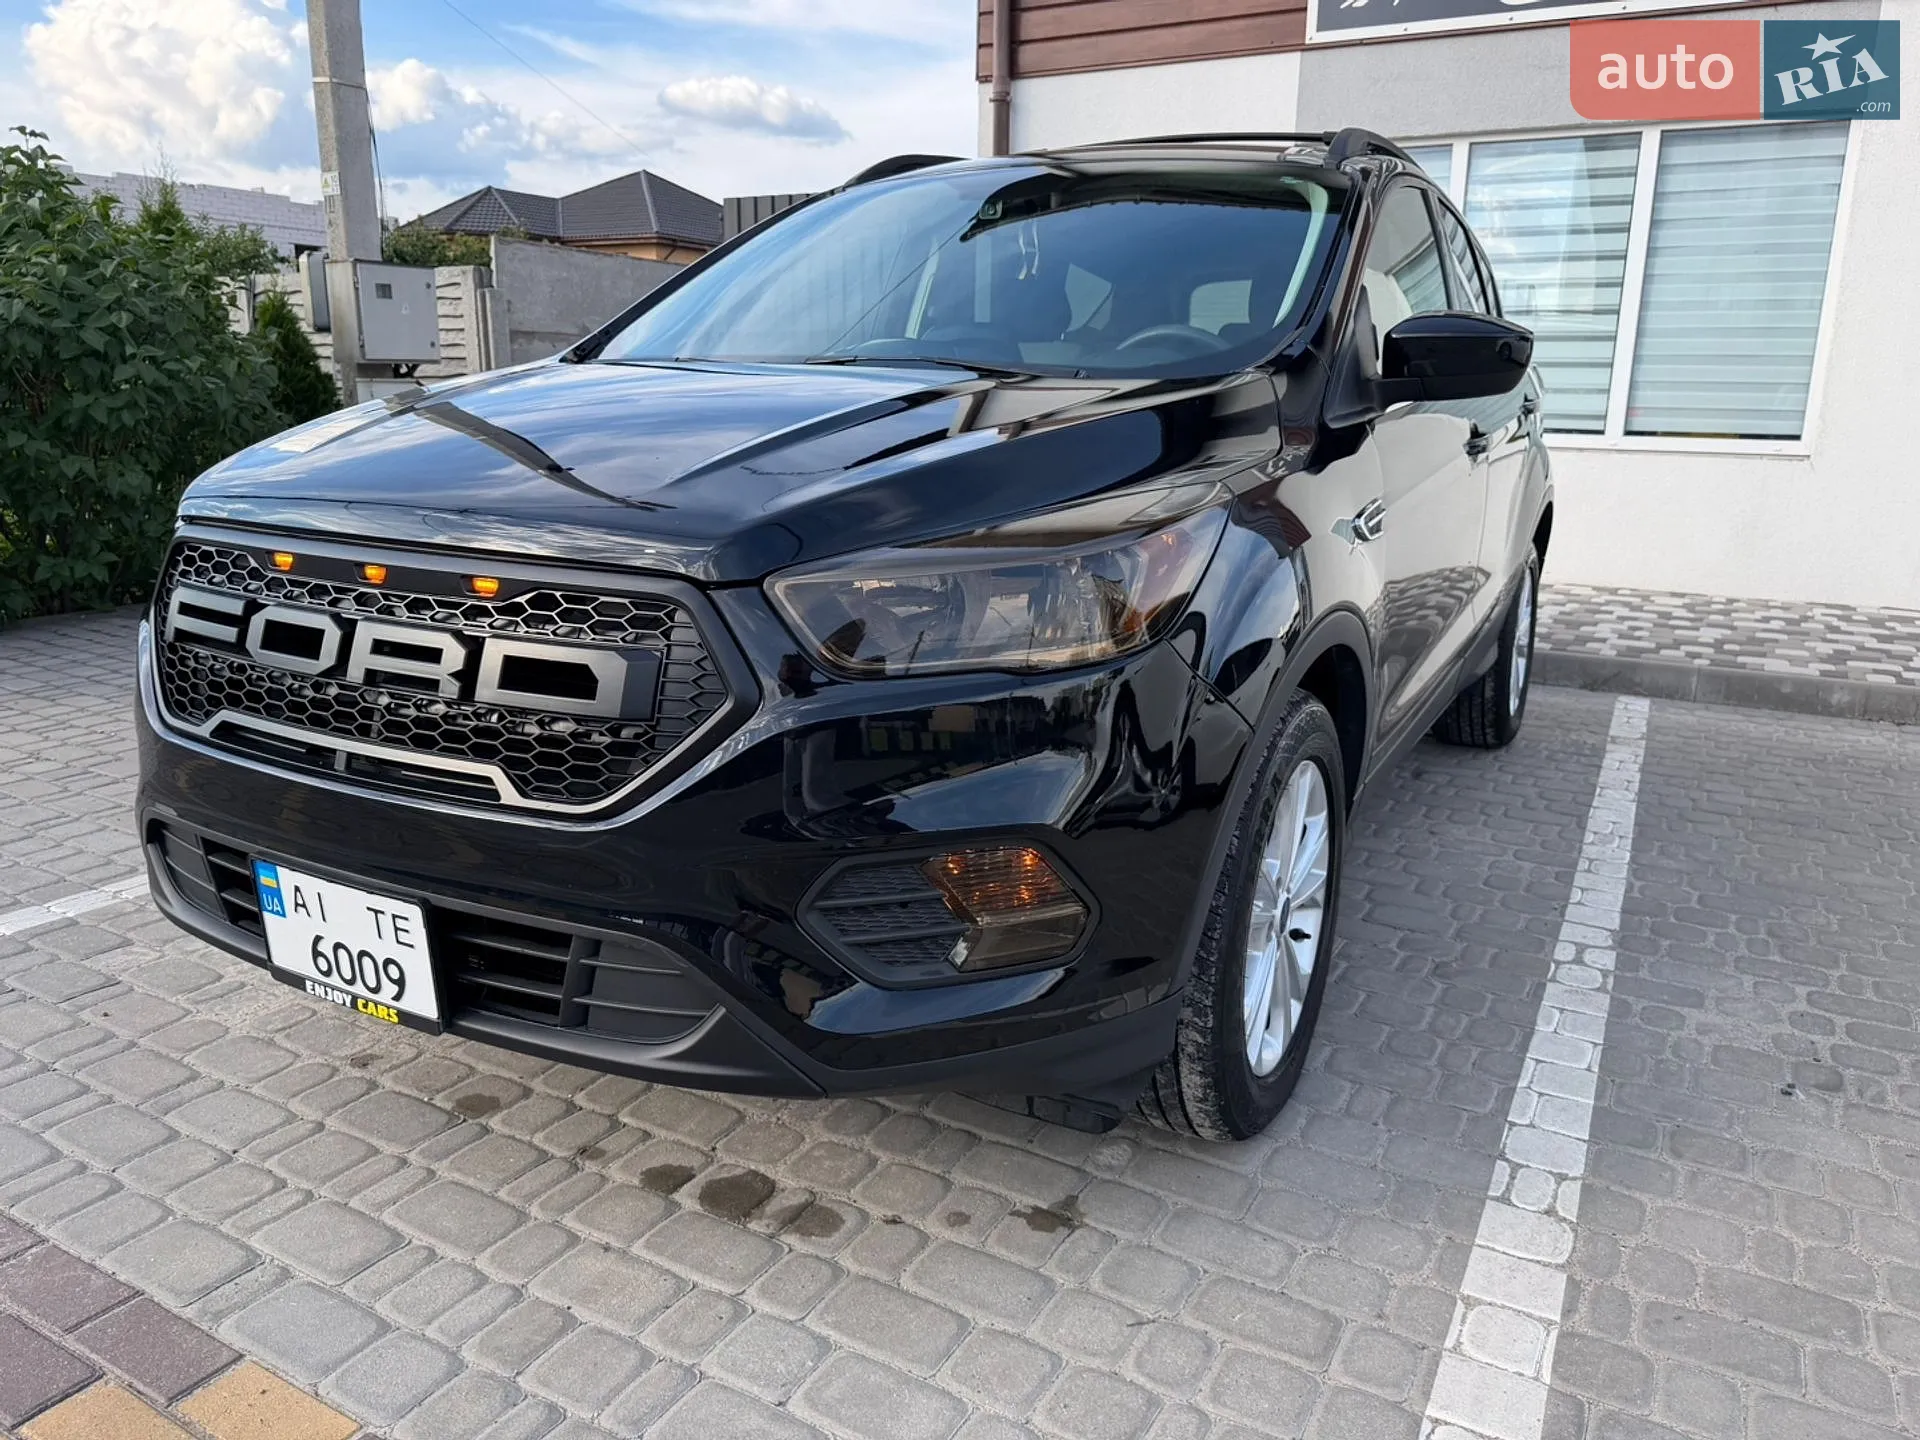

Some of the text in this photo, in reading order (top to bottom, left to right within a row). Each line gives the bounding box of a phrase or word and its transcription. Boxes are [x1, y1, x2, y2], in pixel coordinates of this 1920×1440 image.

[165, 585, 657, 720] FORD
[263, 893, 283, 915] UA
[293, 884, 415, 949] AI TE
[311, 934, 406, 1003] 6009
[305, 980, 400, 1024] ENJOY CARS
